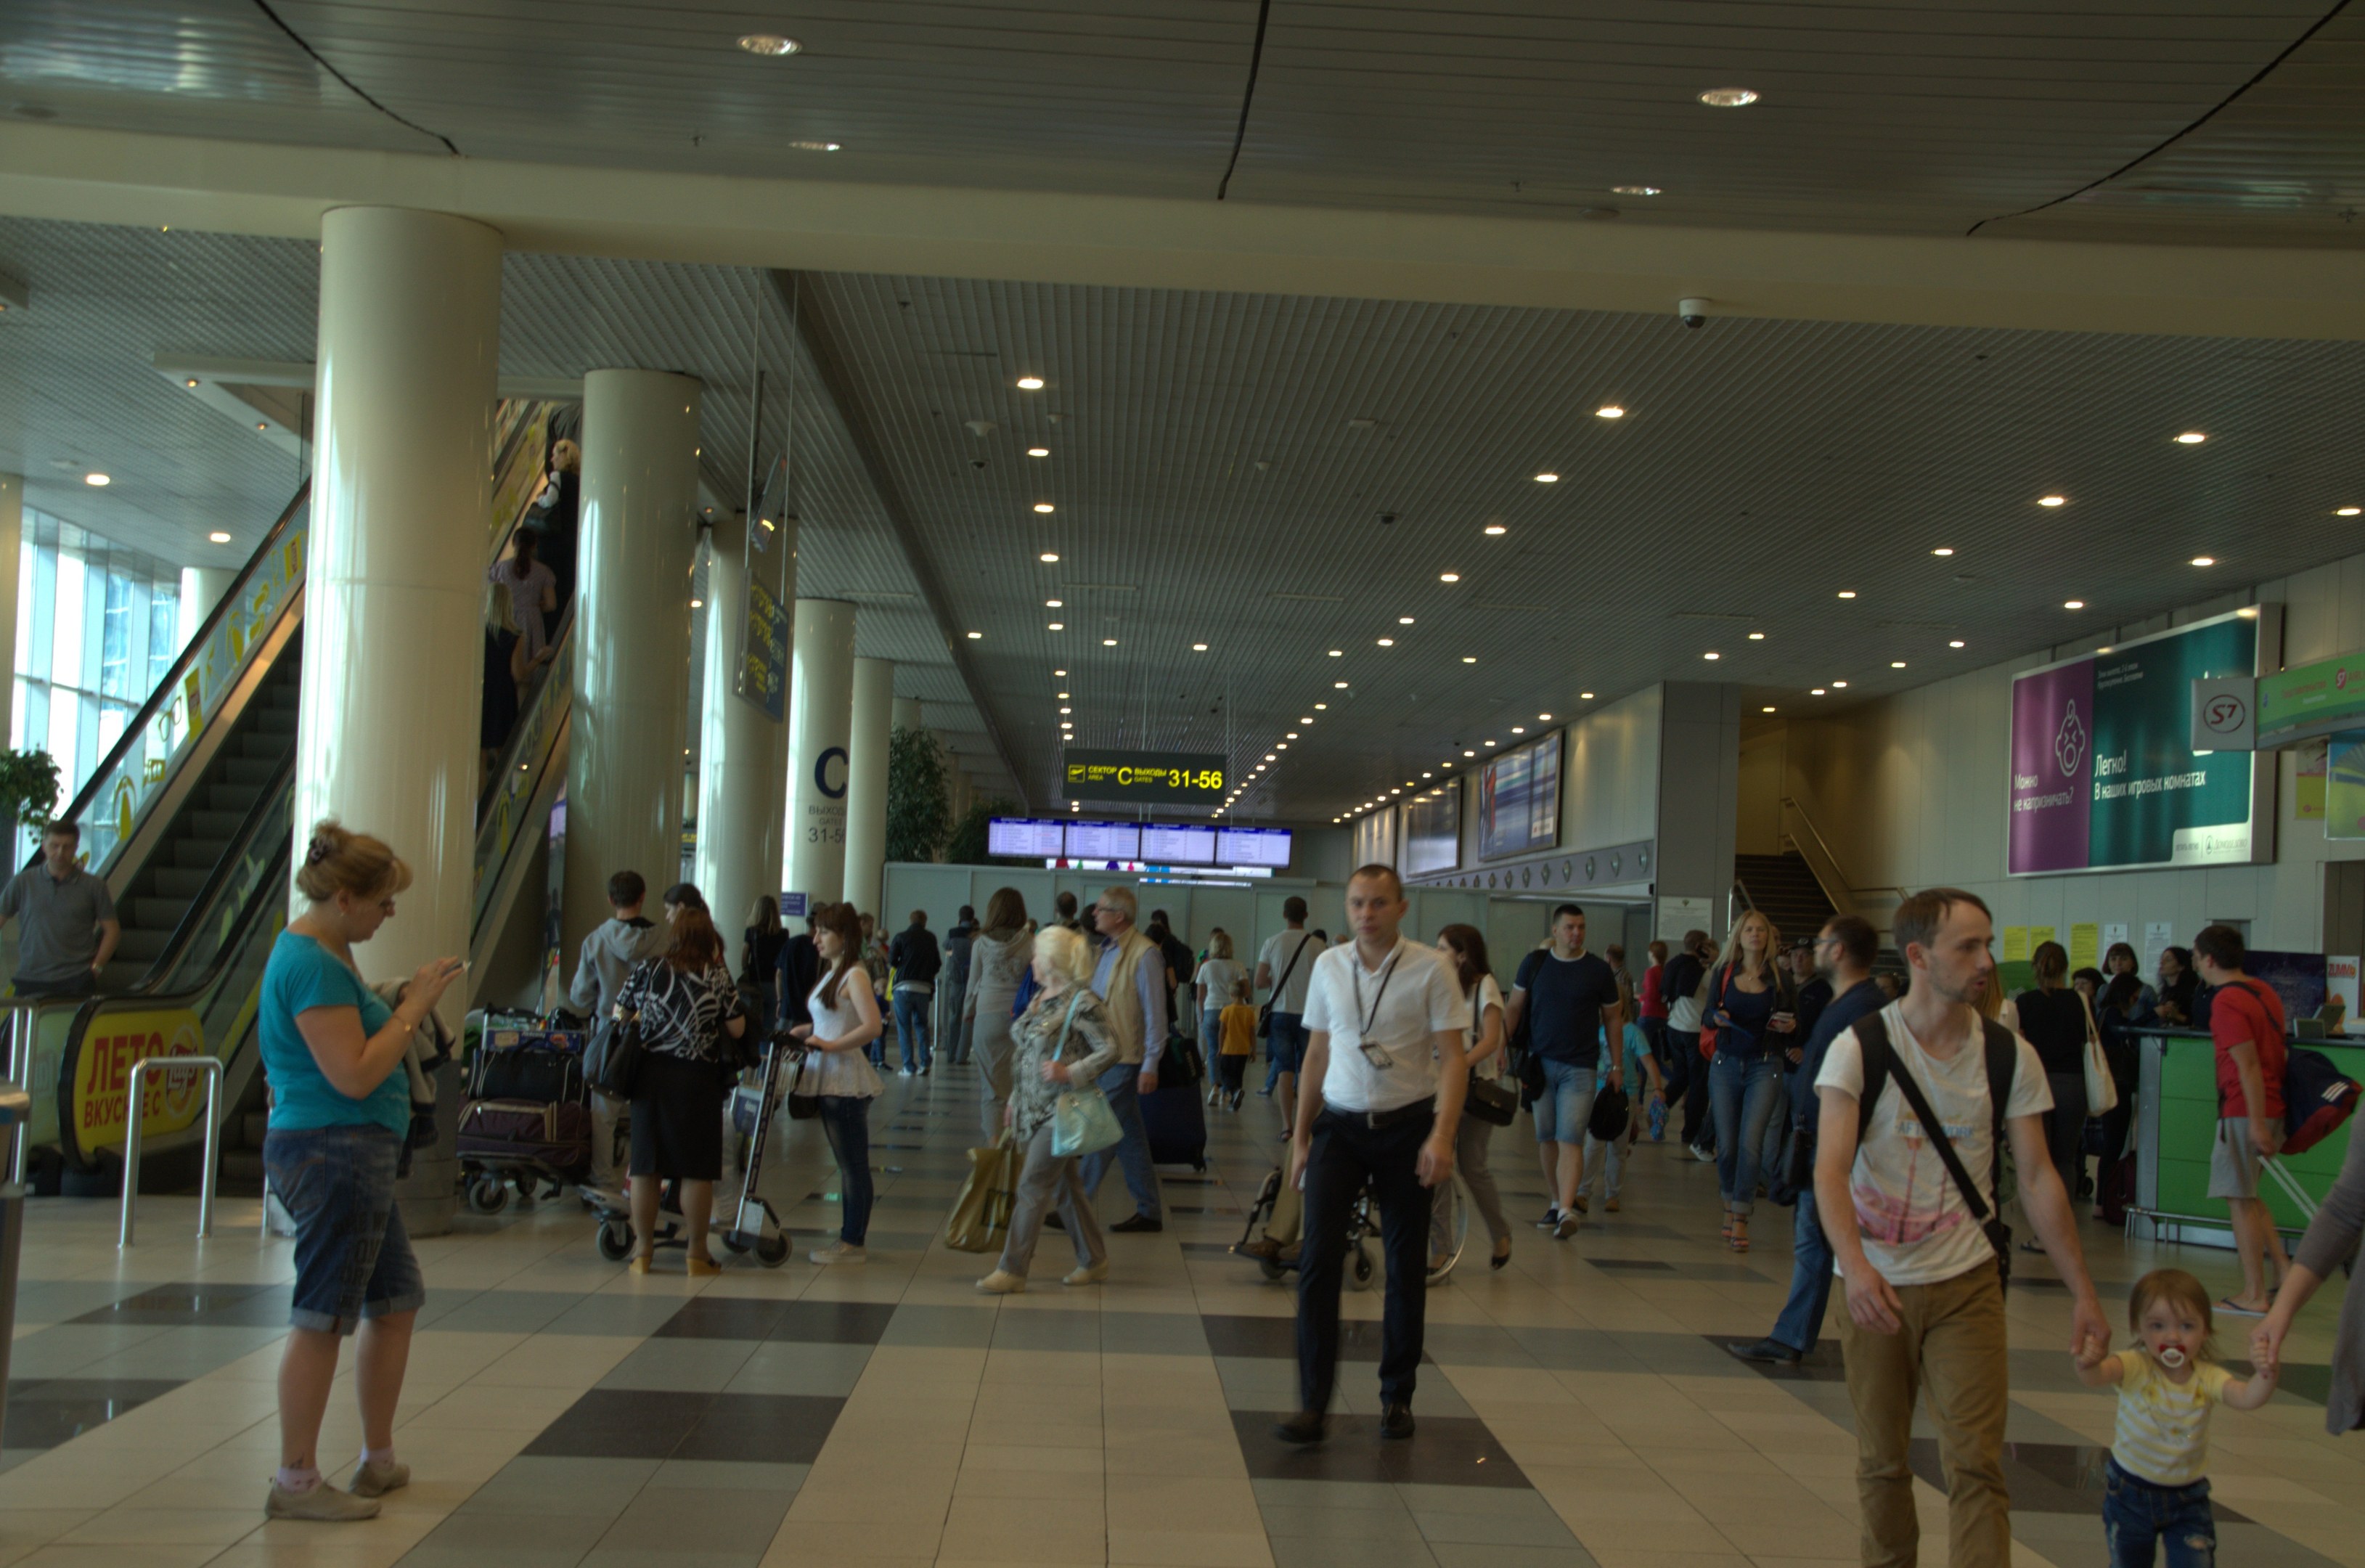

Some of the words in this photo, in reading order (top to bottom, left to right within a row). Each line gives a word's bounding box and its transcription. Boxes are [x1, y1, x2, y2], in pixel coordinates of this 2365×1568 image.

[2210, 703, 2237, 725] S7
[2094, 749, 2127, 777] Легко!
[1088, 766, 1116, 775] СЕКТОР
[1134, 767, 1167, 777] ВЫХОДЫ
[1168, 769, 1223, 789] 31-56
[2014, 773, 2038, 790] Можно
[2094, 783, 2101, 800] В
[2101, 782, 2127, 799] наших
[2128, 775, 2163, 799] игровых
[2163, 770, 2206, 791] комнатах
[2014, 799, 2022, 812] не
[2023, 786, 2074, 810] капризничать?
[809, 806, 846, 817] ВЫХОД
[87, 1032, 164, 1095] ЛЕТО
